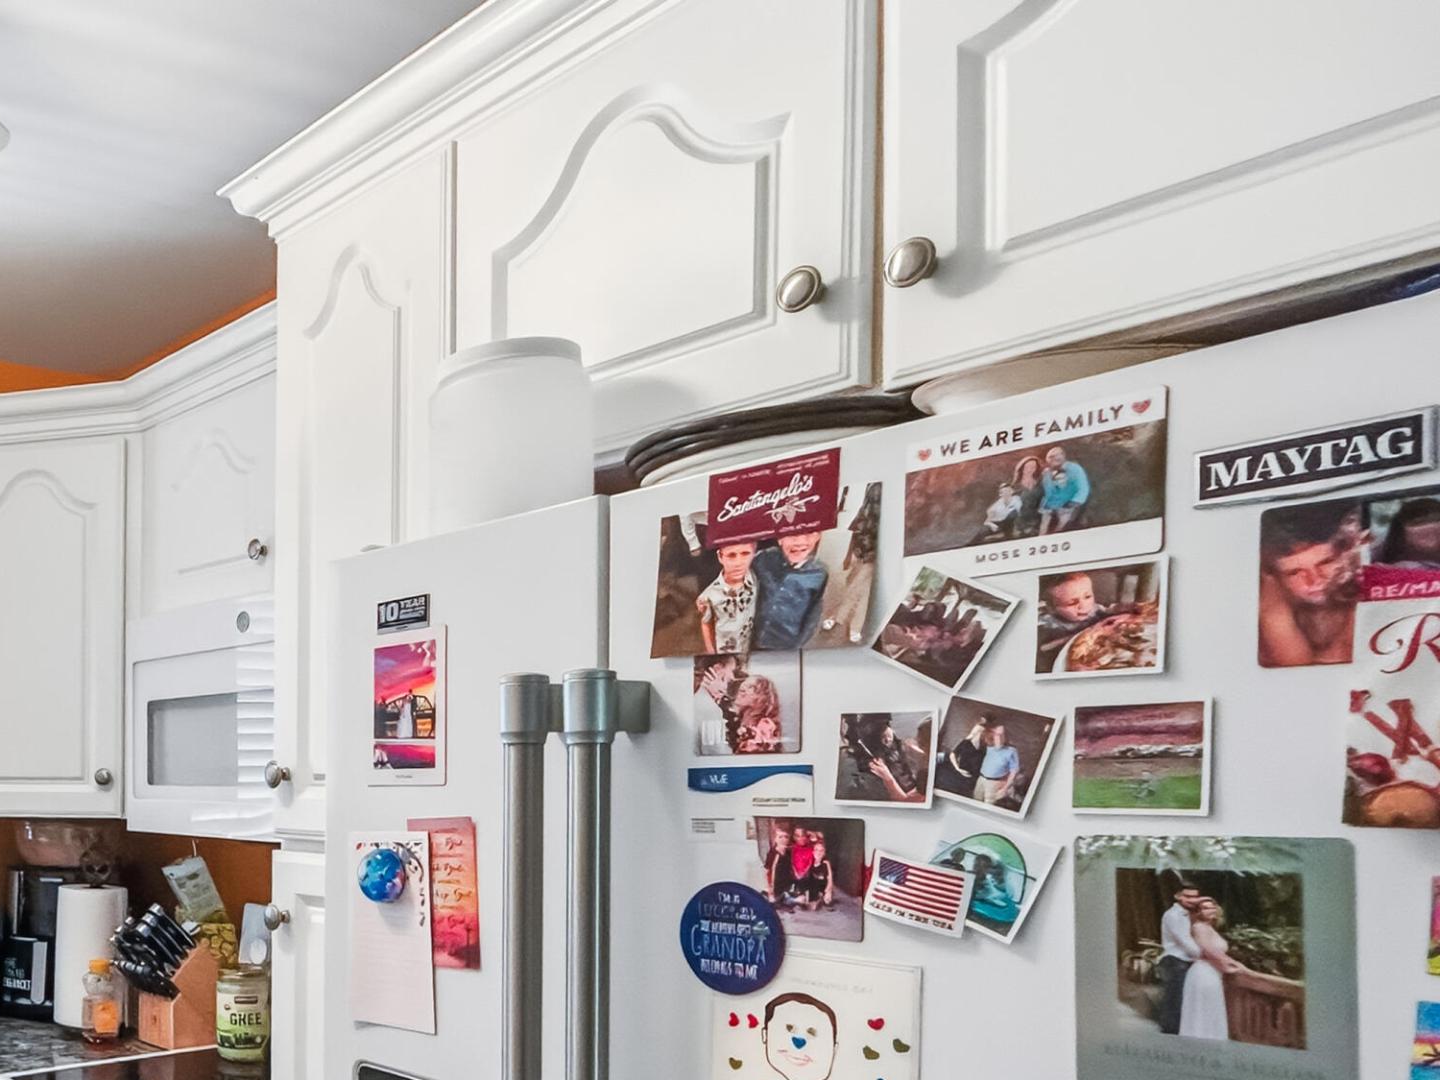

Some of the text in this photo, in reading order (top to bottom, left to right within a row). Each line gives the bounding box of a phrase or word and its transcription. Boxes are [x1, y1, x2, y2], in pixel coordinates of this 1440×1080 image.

[940, 404, 1124, 457] WE ARE FAMILY
[1205, 427, 1415, 491] MAYTAG
[717, 472, 813, 522] Santangelo's
[379, 602, 400, 623] 10
[691, 924, 767, 966] GRANDPA
